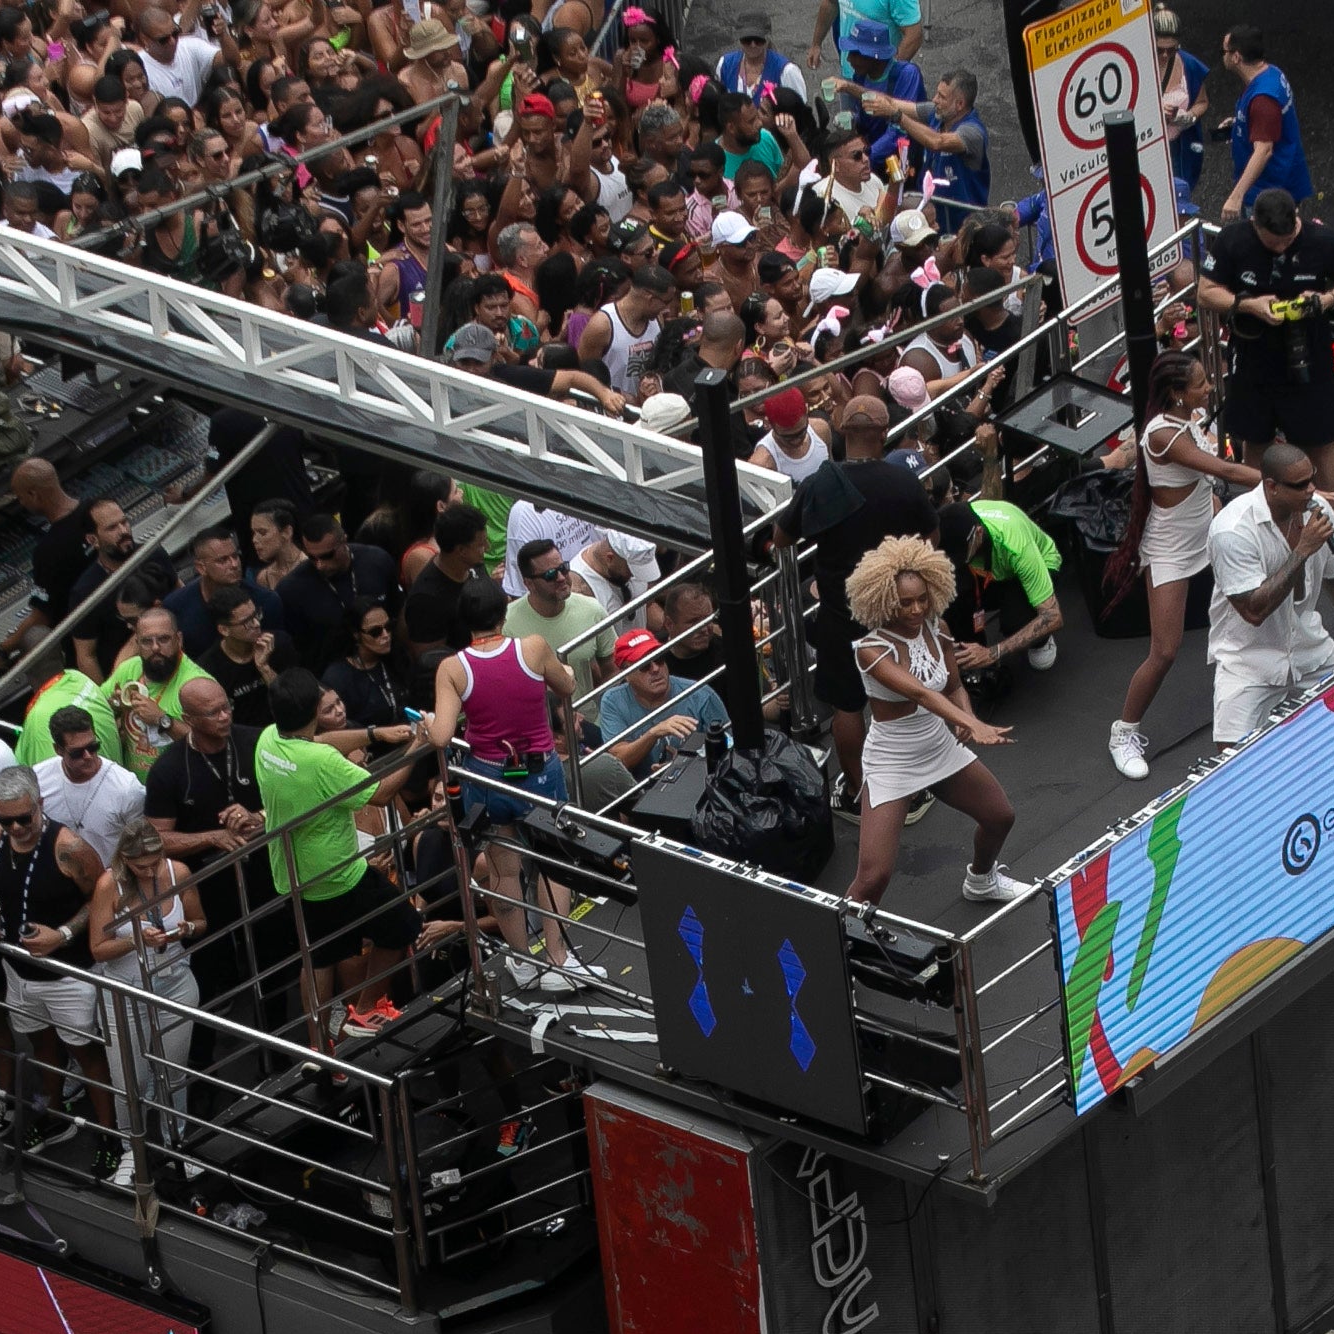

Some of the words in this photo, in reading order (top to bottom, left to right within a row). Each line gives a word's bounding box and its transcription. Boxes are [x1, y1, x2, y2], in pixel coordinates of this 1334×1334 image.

[1035, 0, 1117, 44] Fiscalização
[1045, 17, 1112, 58] Eletrônica
[1074, 62, 1122, 118] 60
[1060, 152, 1108, 184] Veículo
[1091, 198, 1115, 247] 5
[1149, 249, 1176, 272] ados
